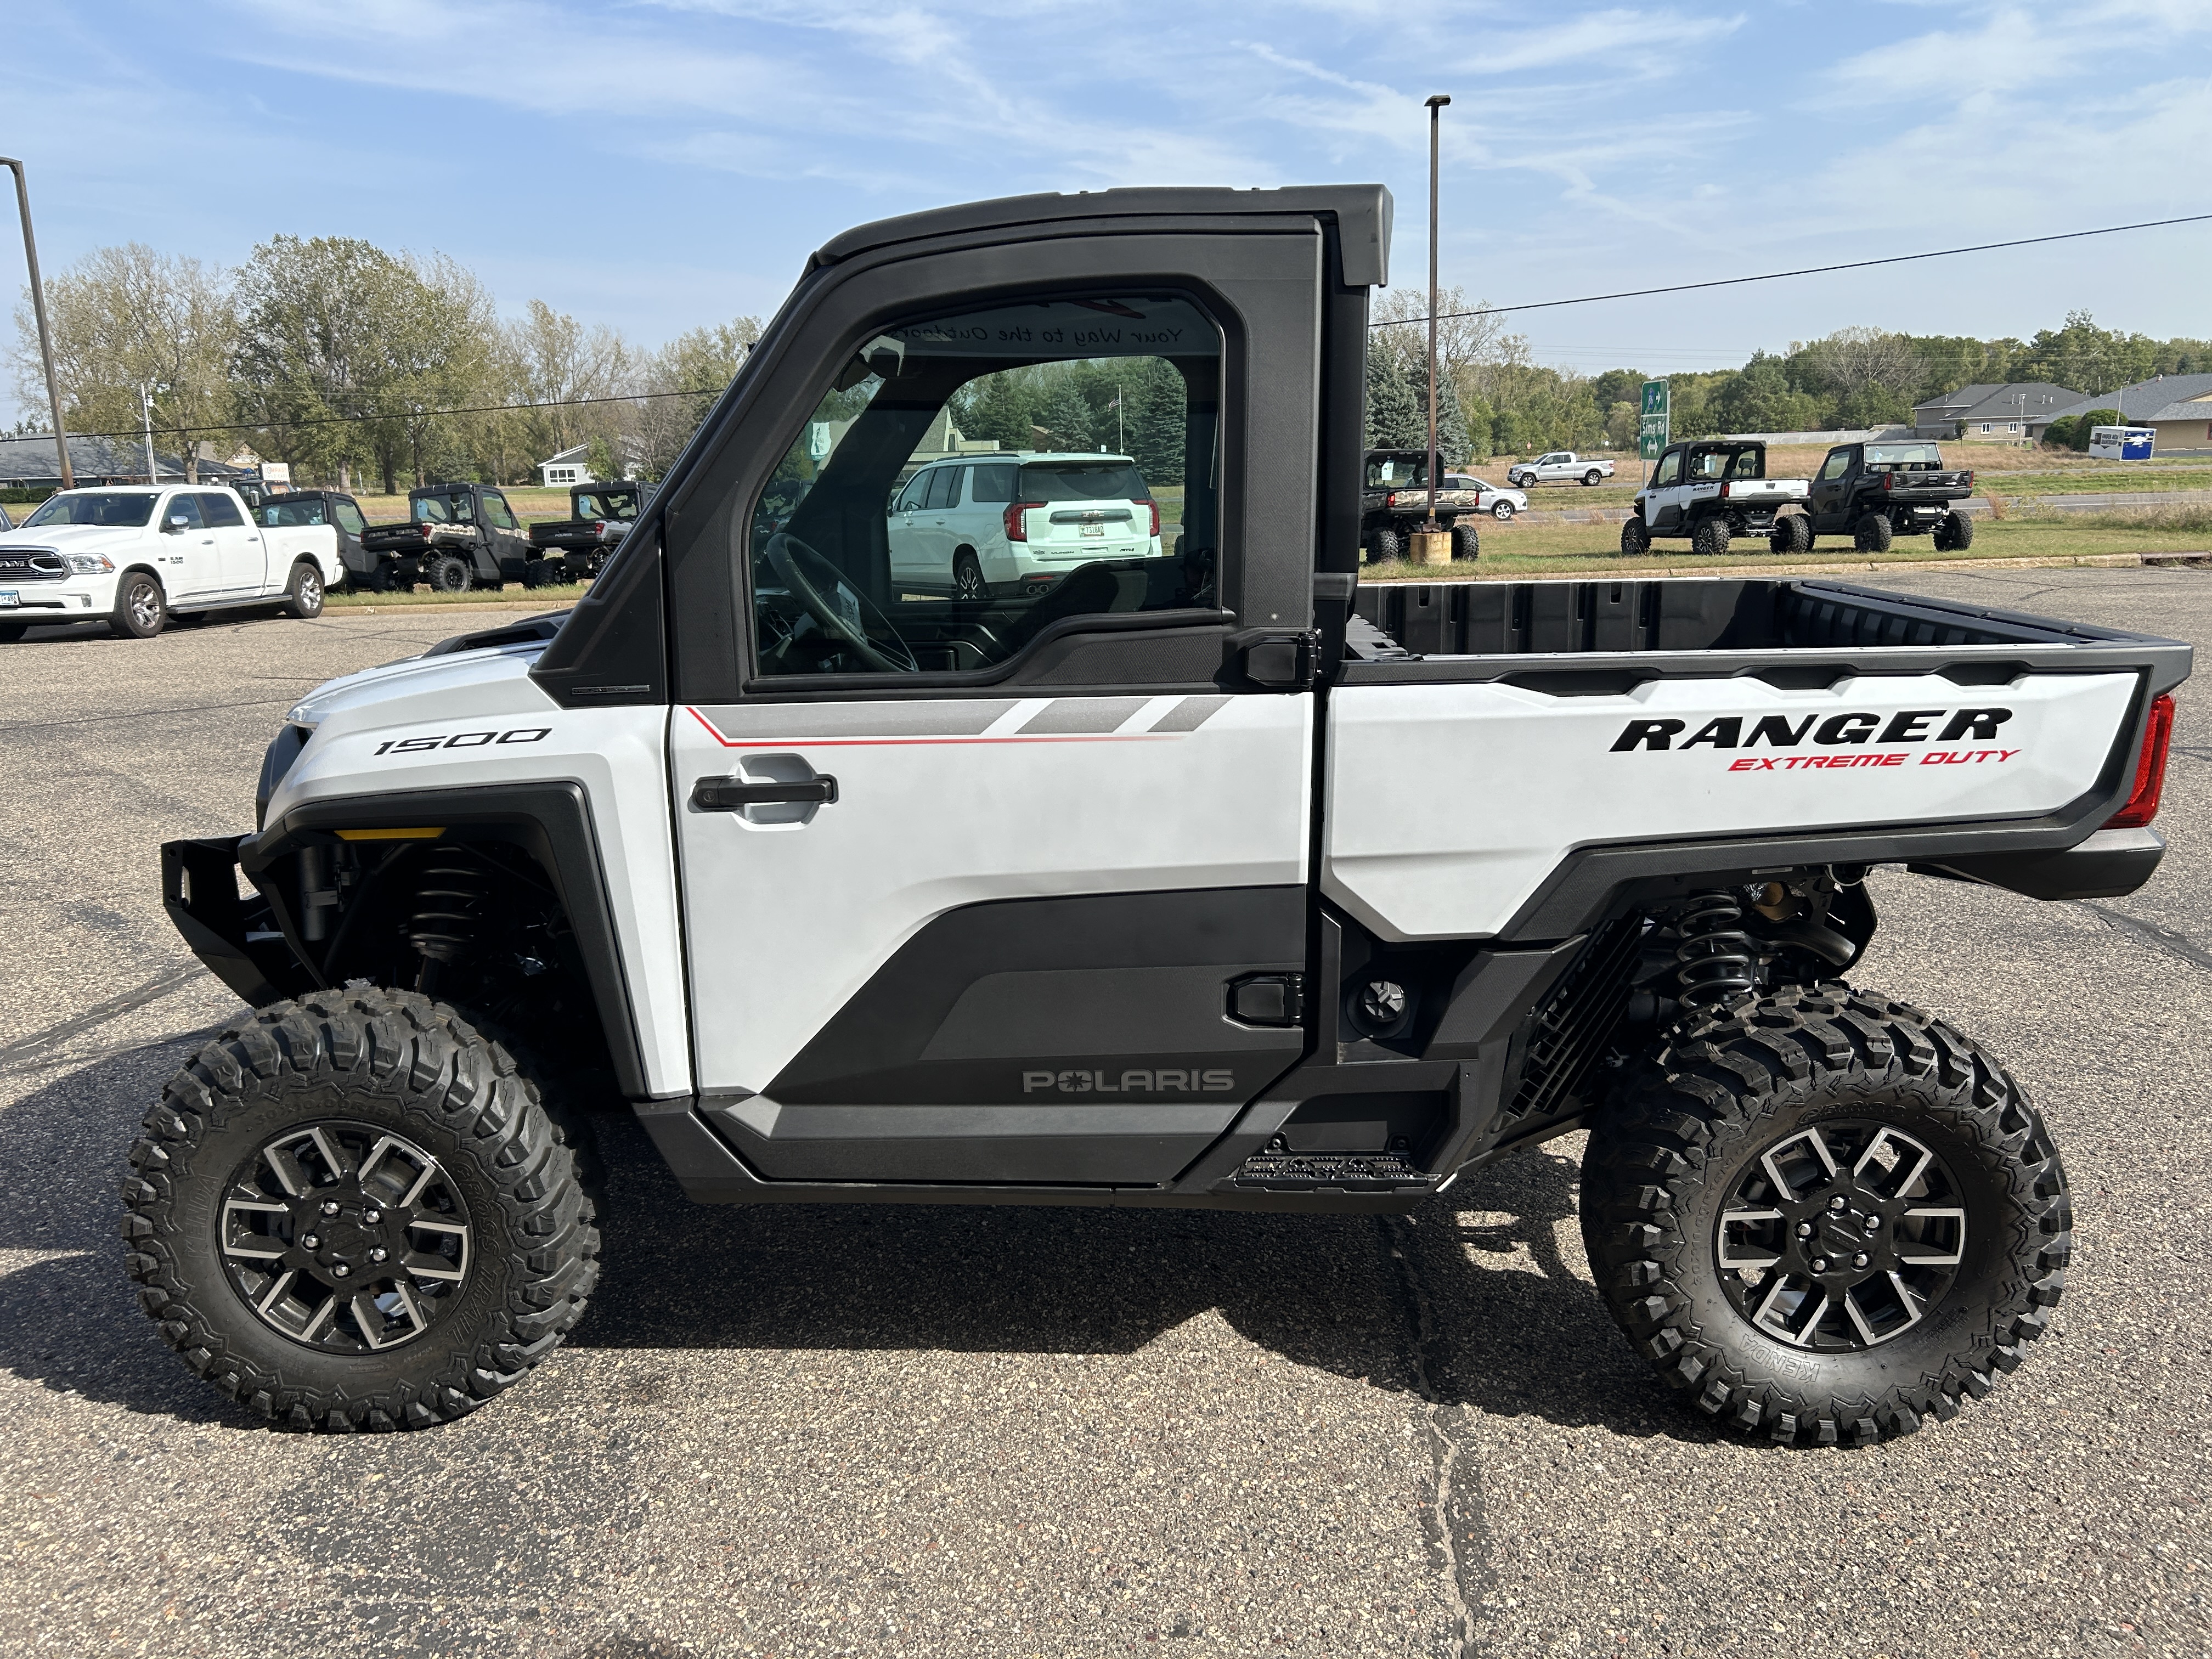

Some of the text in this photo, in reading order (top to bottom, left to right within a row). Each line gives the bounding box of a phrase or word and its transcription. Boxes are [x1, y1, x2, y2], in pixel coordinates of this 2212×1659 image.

[1643, 420, 1665, 435] Sims Rd
[374, 728, 552, 756] 1500
[1609, 707, 2013, 753] RANGER
[1727, 748, 2021, 771] EXTREME DUTY
[1023, 1069, 1235, 1093] POLARIS
[185, 1173, 219, 1258] KENDA
[447, 1159, 500, 1344] CROSS TRAIL
[1739, 1333, 1820, 1382] KENDA
